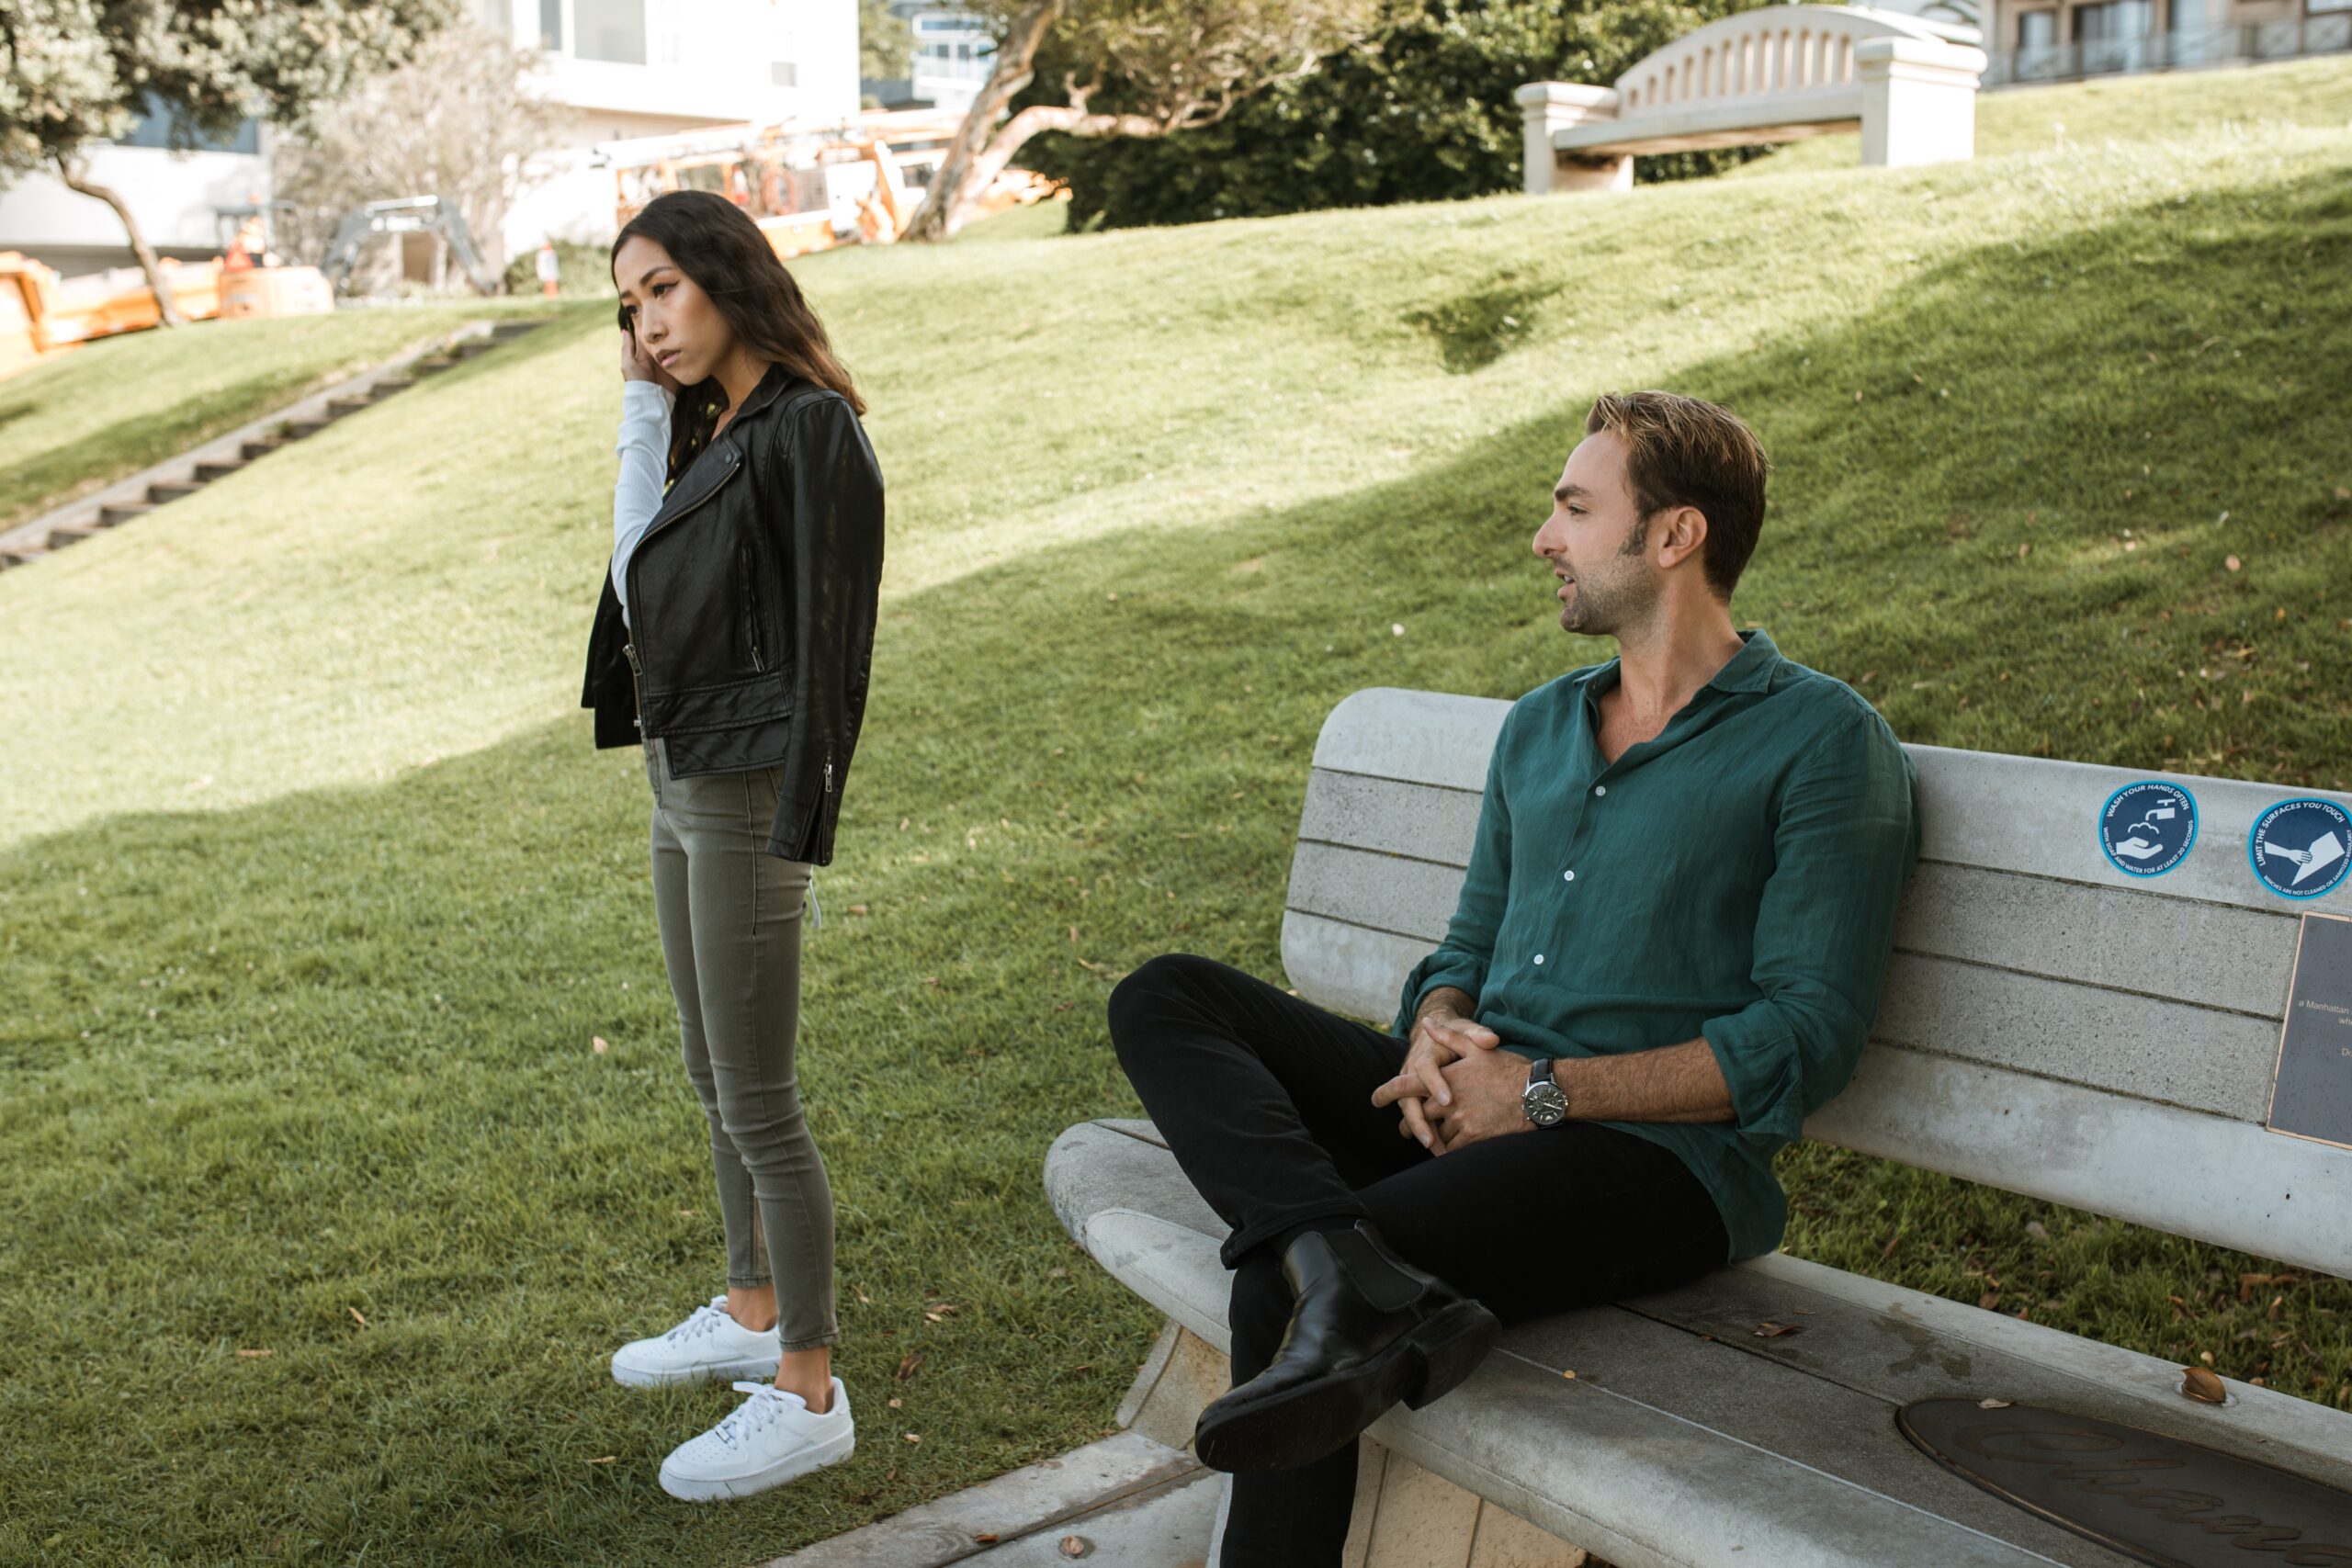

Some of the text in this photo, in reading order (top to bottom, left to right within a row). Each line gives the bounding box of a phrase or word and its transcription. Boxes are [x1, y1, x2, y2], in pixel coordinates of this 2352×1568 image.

[2107, 784, 2189, 818] WASH YOUR HANDS OFTEN
[2262, 802, 2301, 829] SURFACES
[2322, 805, 2346, 823] TOUCH
[2256, 828, 2266, 844] THE
[2106, 841, 2117, 856] SOAP
[2115, 856, 2125, 867] AND
[2125, 863, 2143, 874] WATER
[2164, 853, 2178, 868] LEAST
[2256, 846, 2266, 867] LIMIT
[2303, 885, 2326, 896] CLEANED
[2325, 879, 2334, 887] OR
[2306, 1000, 2349, 1014] Manhattan
